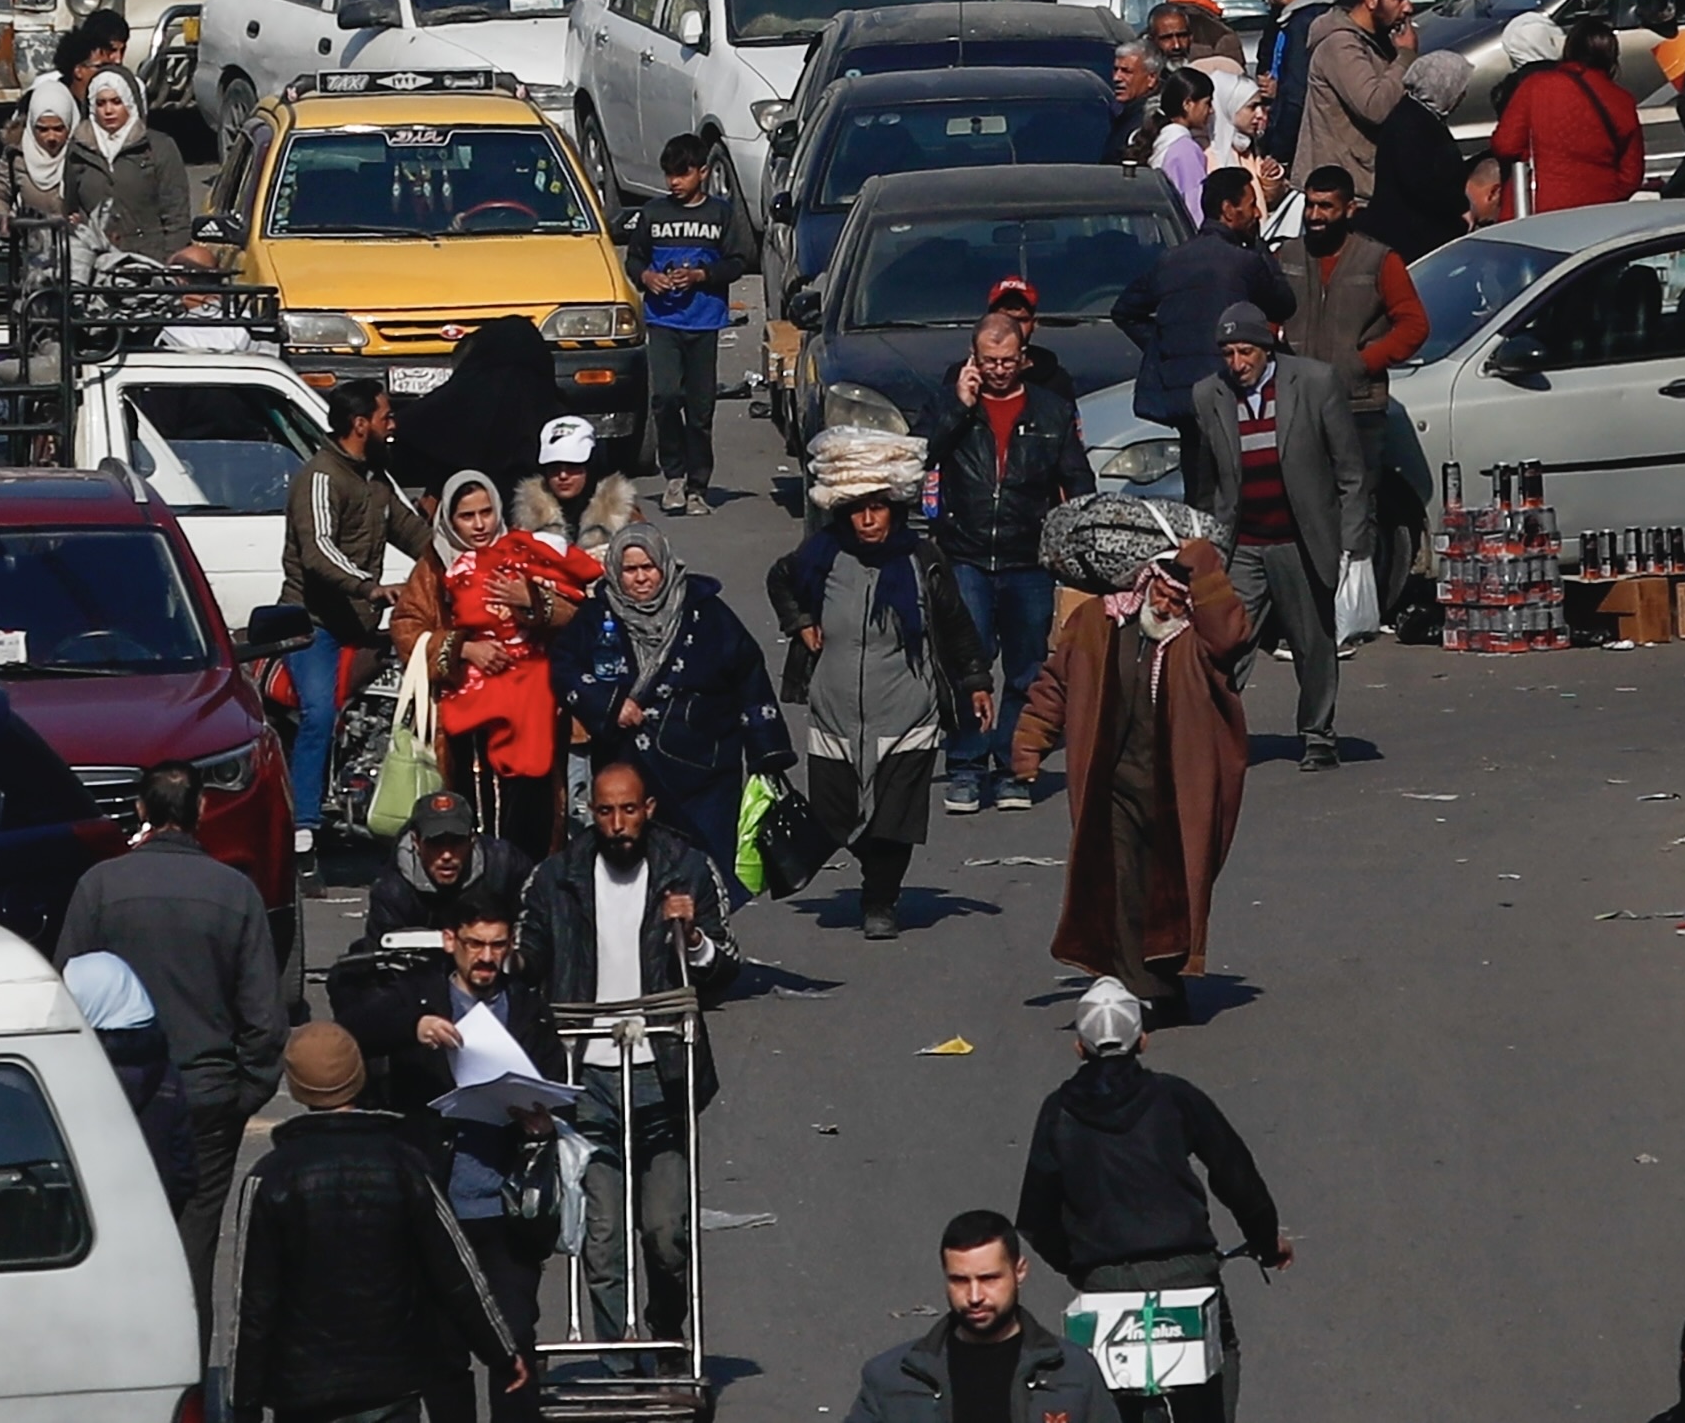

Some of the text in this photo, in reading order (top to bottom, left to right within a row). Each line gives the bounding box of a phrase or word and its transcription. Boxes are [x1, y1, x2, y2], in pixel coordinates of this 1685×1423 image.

[327, 74, 370, 91] TAXI
[651, 221, 722, 240] BATMAN
[1114, 1316, 1183, 1341] Analus
